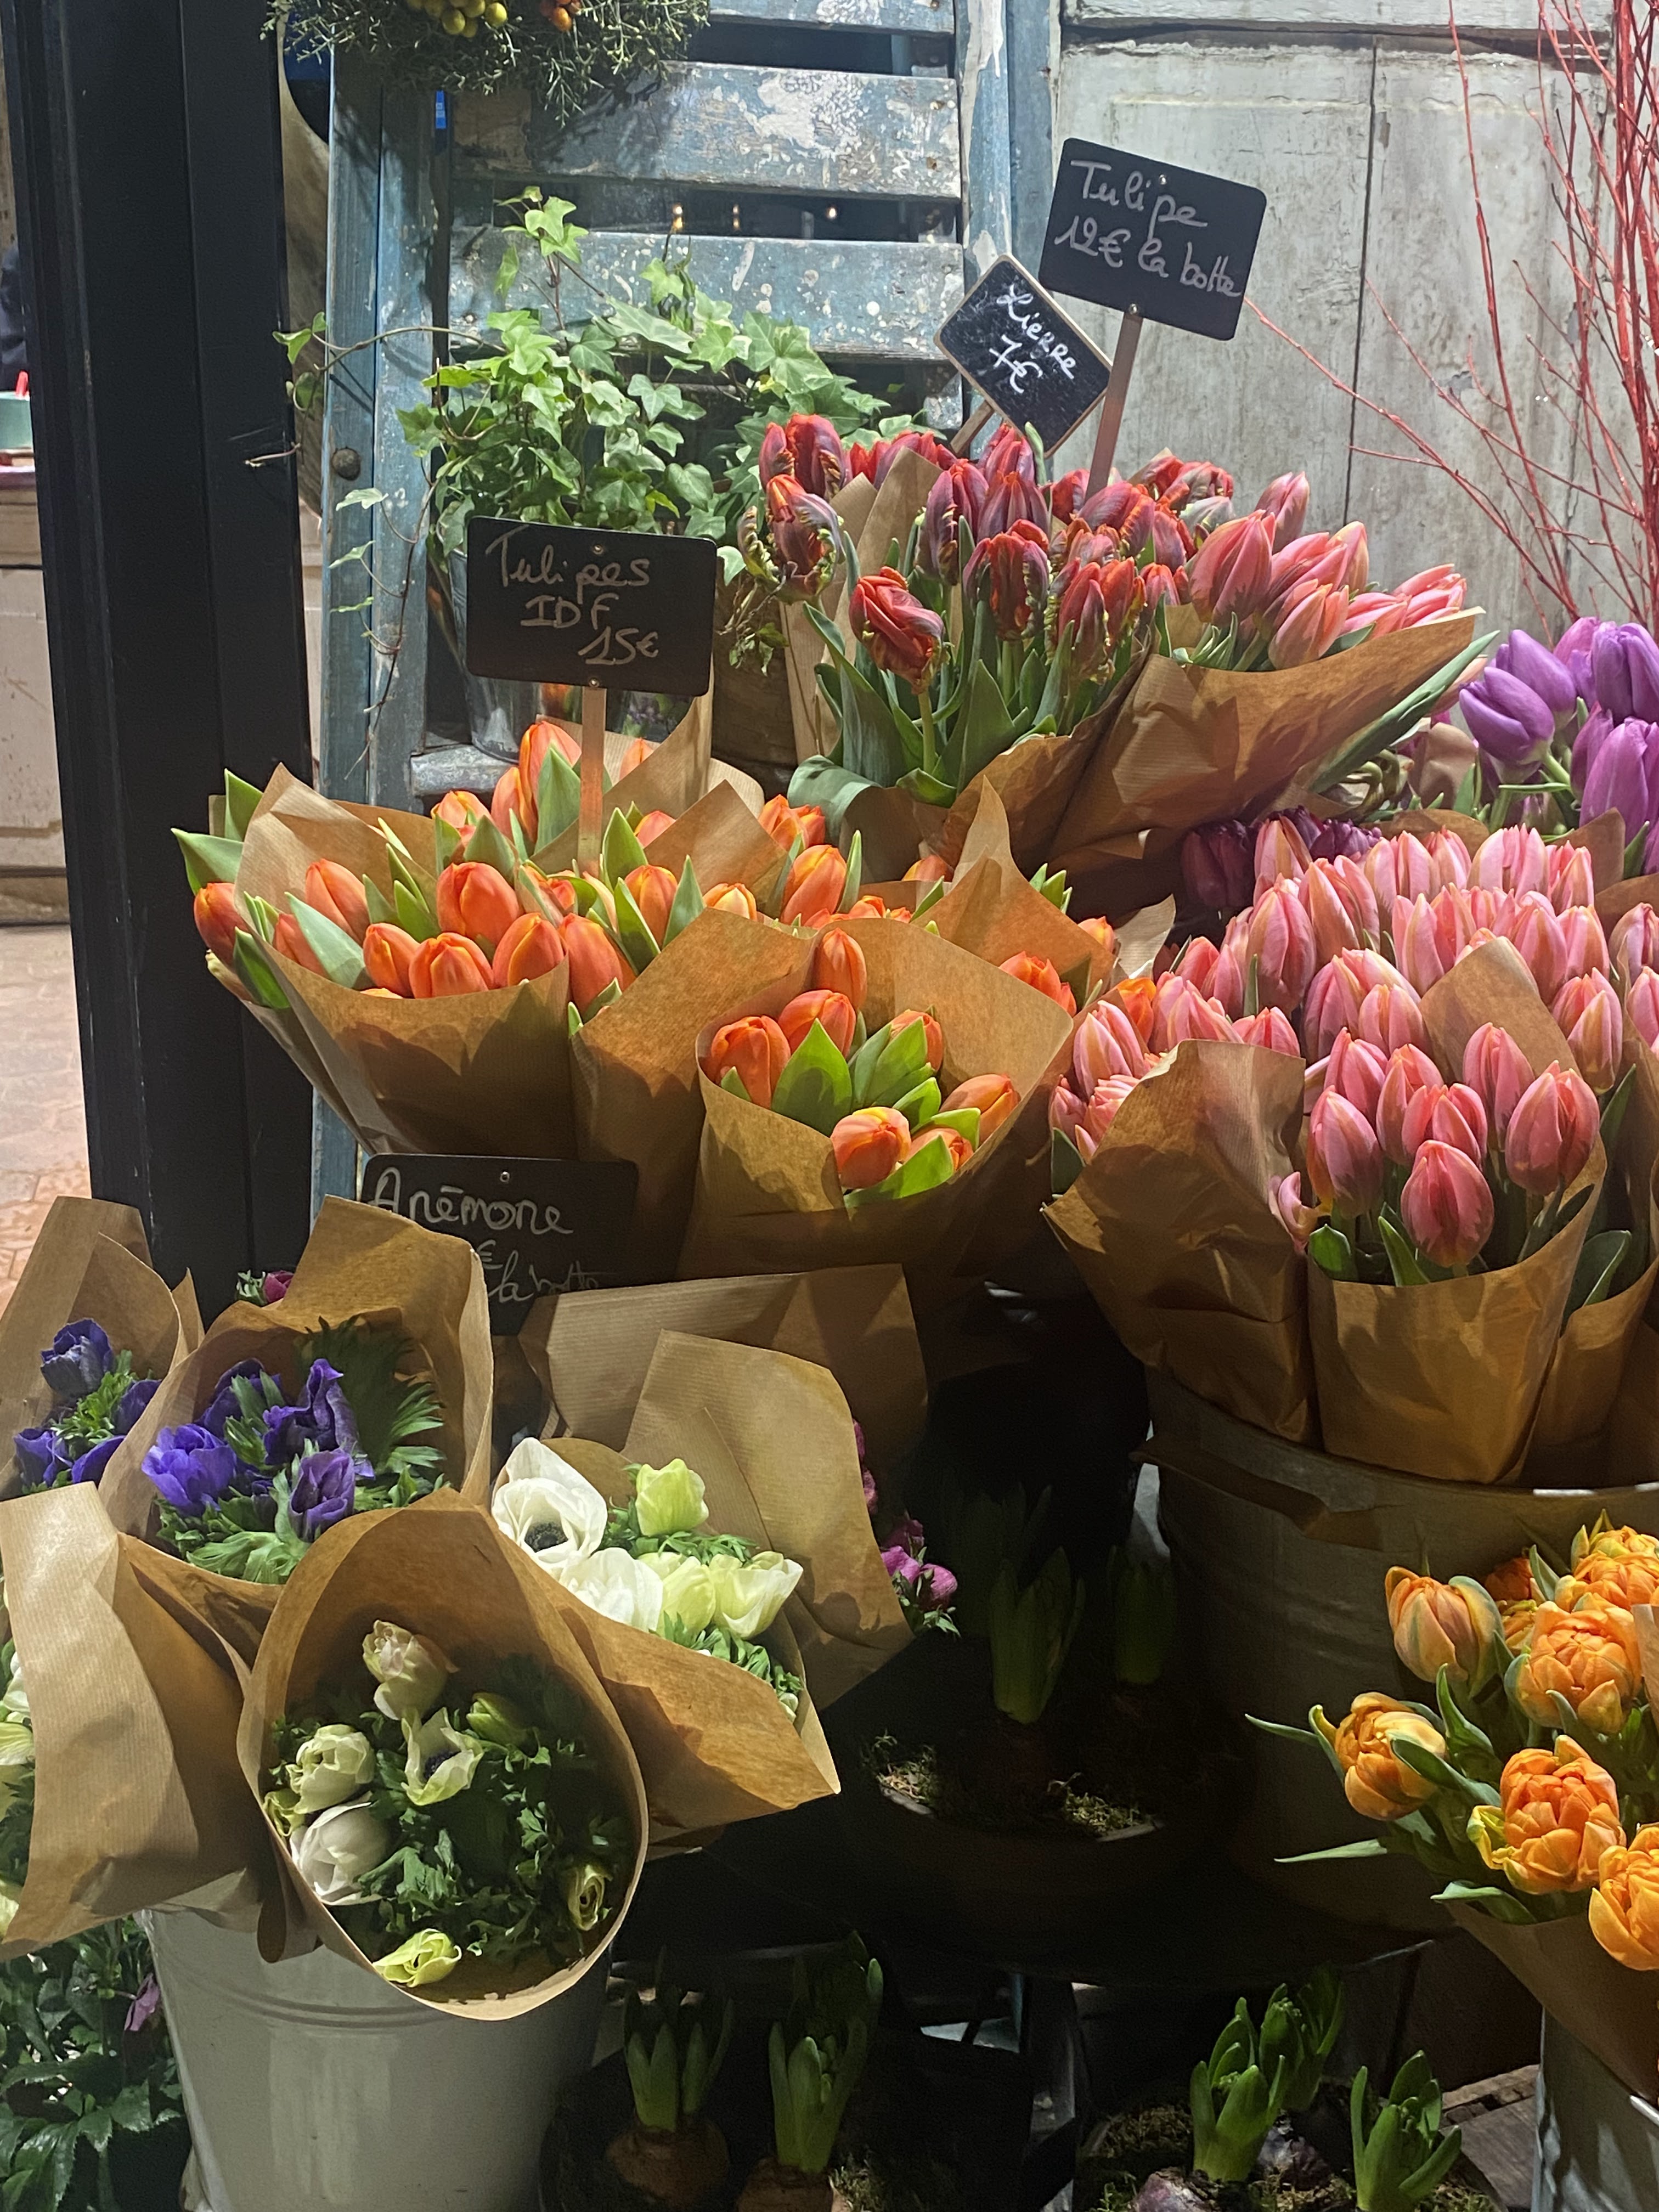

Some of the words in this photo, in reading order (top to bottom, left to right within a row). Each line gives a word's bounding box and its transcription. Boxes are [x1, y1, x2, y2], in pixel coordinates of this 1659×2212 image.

[1070, 160, 1208, 239] Tulipe
[1054, 215, 1131, 268] 12€
[1137, 237, 1169, 278] la
[1179, 241, 1242, 297] botte
[989, 335, 1043, 394] 7€
[485, 524, 650, 604] Tulipes
[520, 592, 619, 629] IDF
[578, 626, 659, 665] 15€
